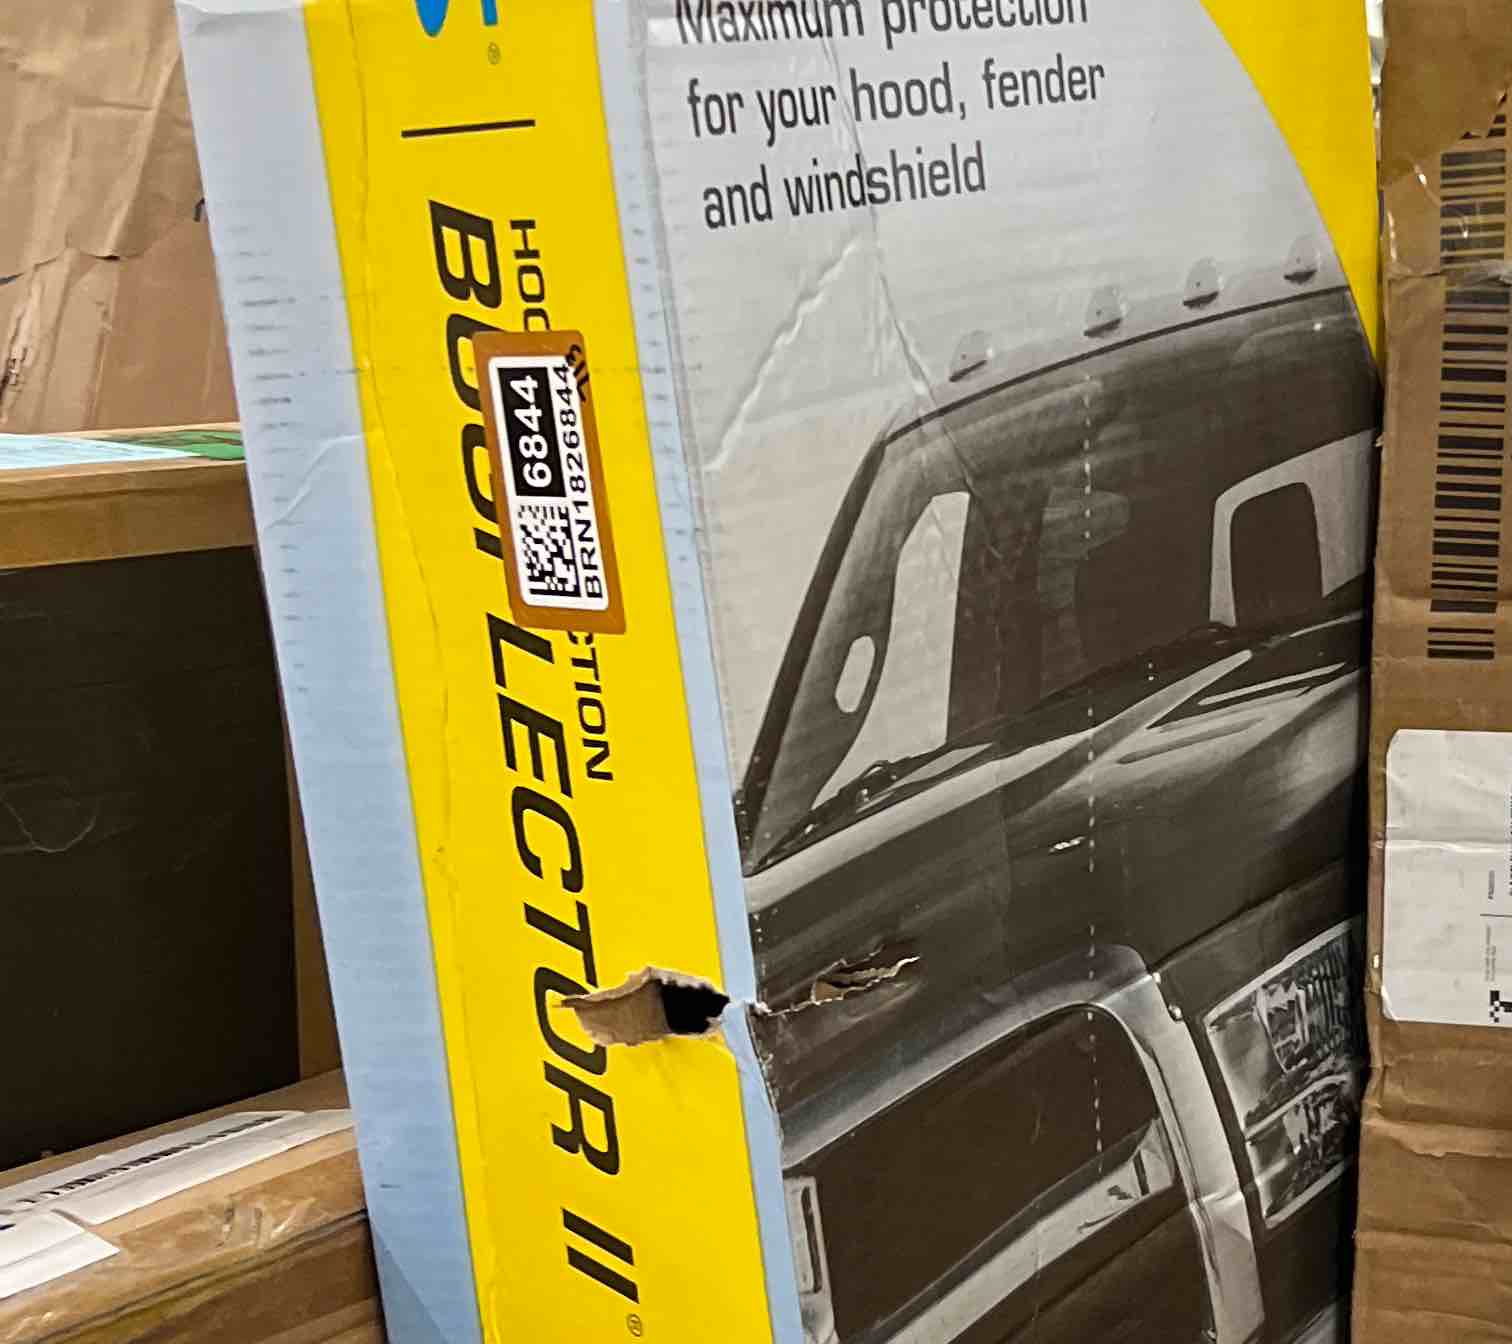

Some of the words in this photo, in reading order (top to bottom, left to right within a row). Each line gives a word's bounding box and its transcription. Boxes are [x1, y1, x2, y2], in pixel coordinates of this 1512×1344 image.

[687, 78, 743, 138] for
[757, 83, 837, 147] your
[849, 61, 967, 123] hood,
[982, 55, 1105, 111] fender
[703, 164, 773, 229] and
[784, 141, 987, 218] windshield
[509, 373, 553, 489] 6844
[552, 362, 605, 599] BRN1826844
